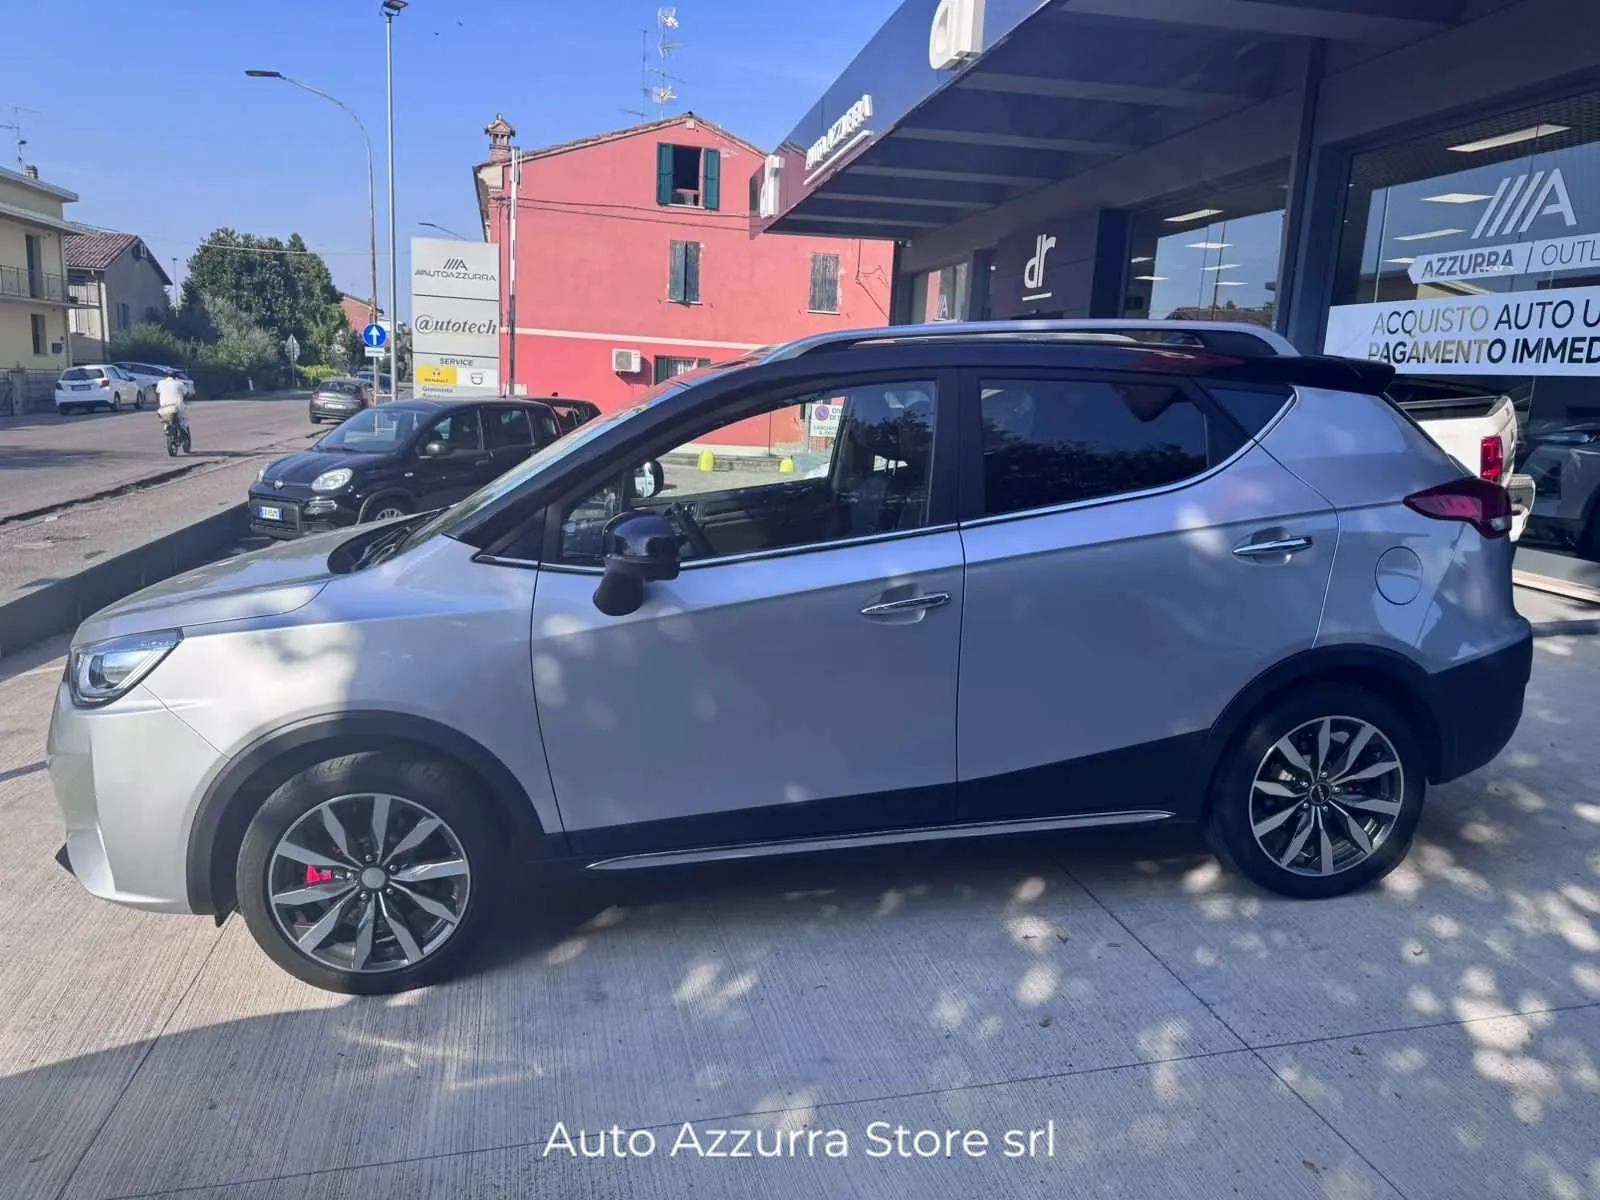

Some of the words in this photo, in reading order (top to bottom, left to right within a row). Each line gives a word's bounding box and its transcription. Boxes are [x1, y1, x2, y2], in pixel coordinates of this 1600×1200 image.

[1024, 234, 1056, 288] dr
[1421, 249, 1514, 279] AZZURRA
[1371, 305, 1489, 337] ACQUISTO
[1494, 300, 1574, 331] AUTO
[440, 358, 473, 366] SERVICE
[1368, 338, 1507, 364] PAGAMENTO
